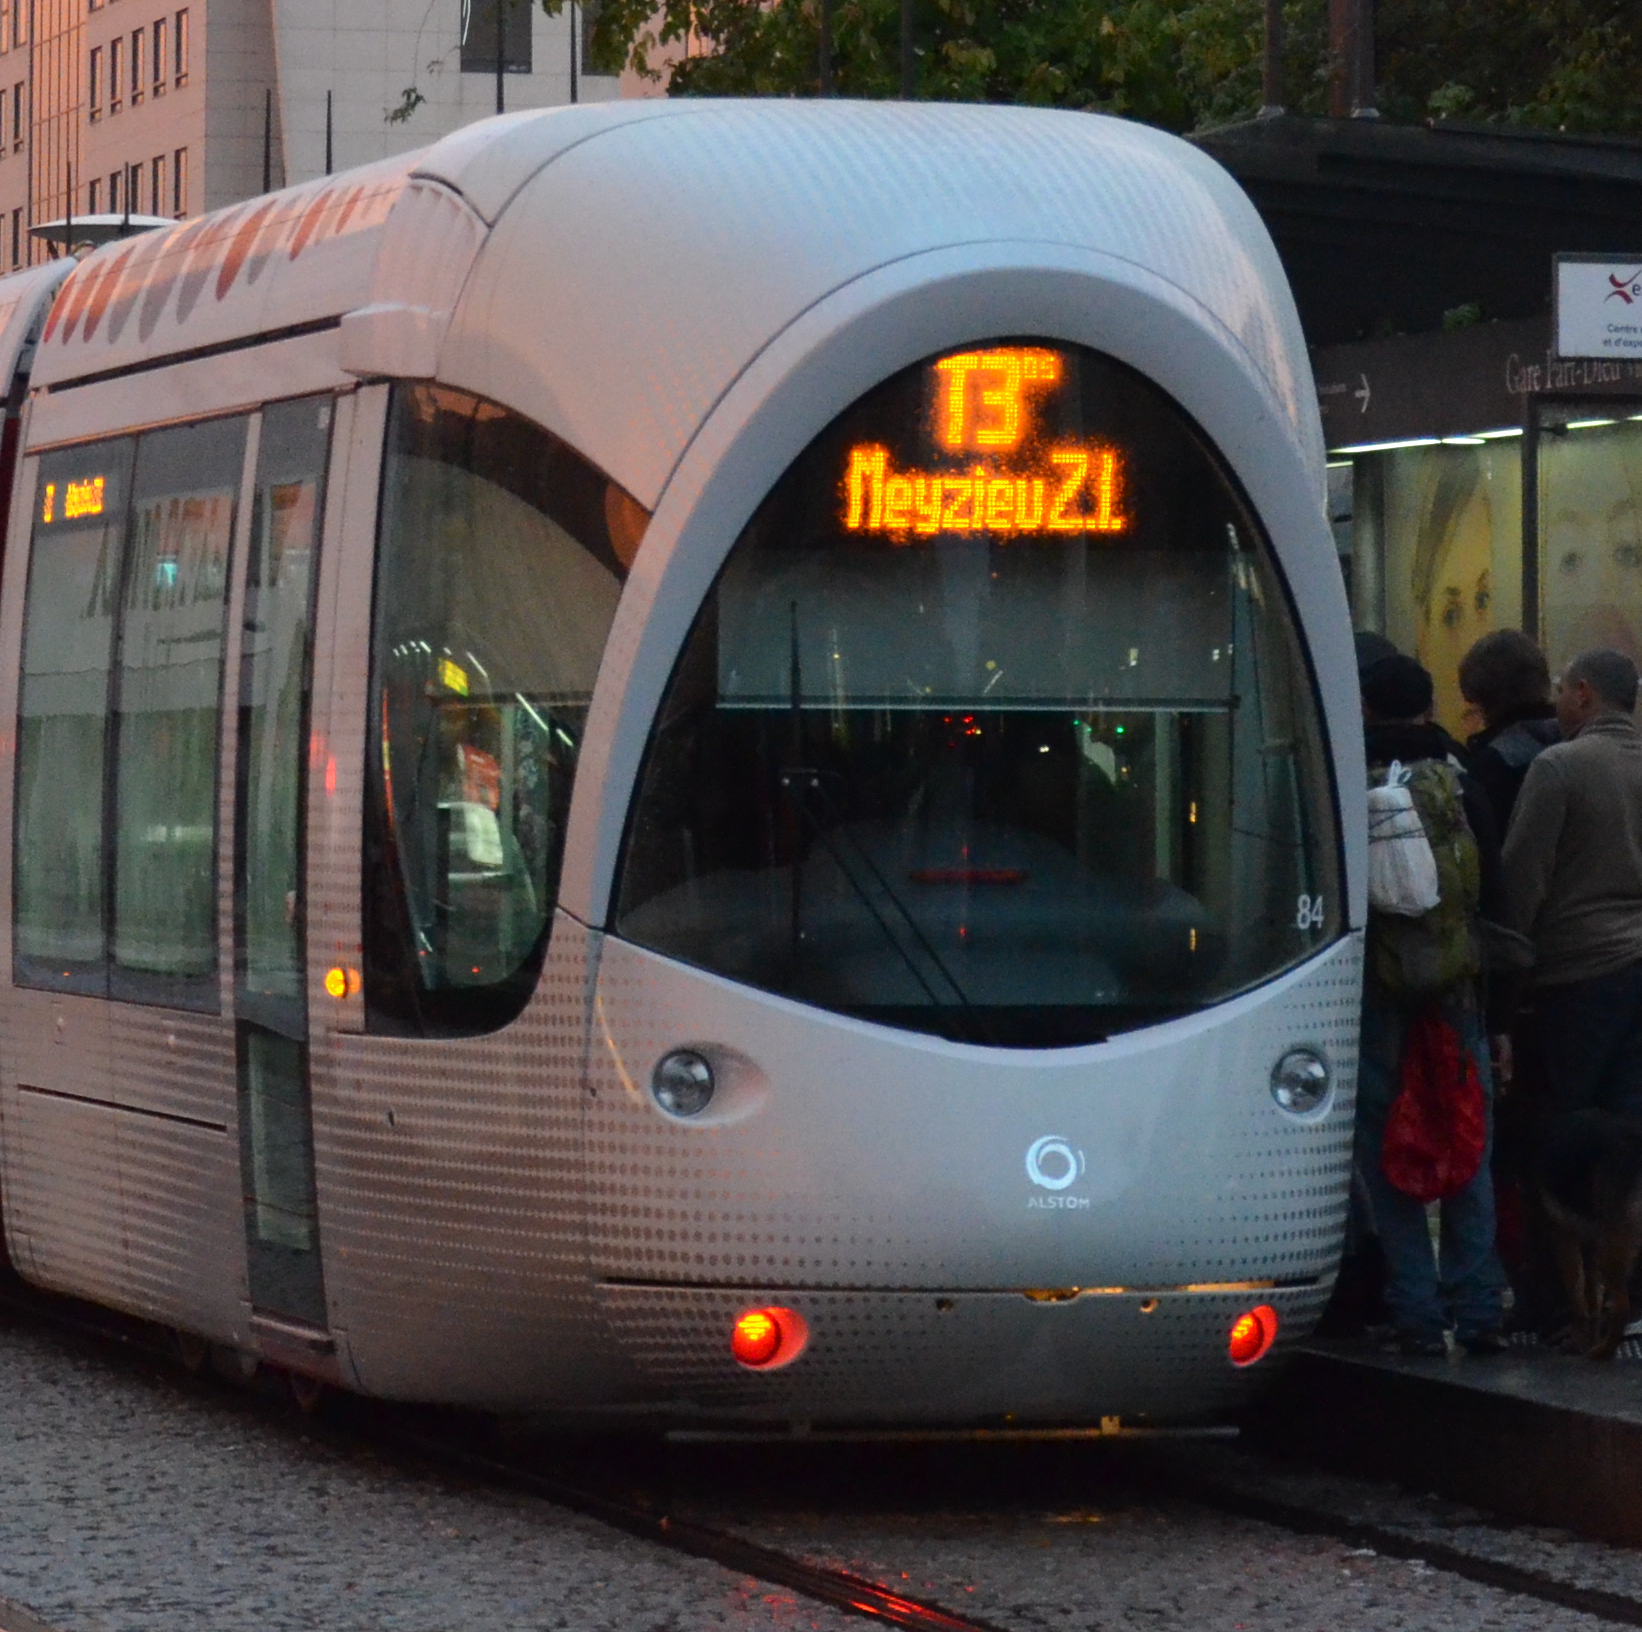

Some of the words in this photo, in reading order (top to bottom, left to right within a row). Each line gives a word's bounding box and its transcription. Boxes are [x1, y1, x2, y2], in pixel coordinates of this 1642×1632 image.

[1607, 323, 1638, 334] Centre
[1506, 353, 1542, 394] Gare
[937, 354, 1021, 445] T3
[847, 451, 1044, 534] Meyzieu
[1297, 894, 1325, 930] 84
[1027, 1196, 1090, 1209] ALSTOM
